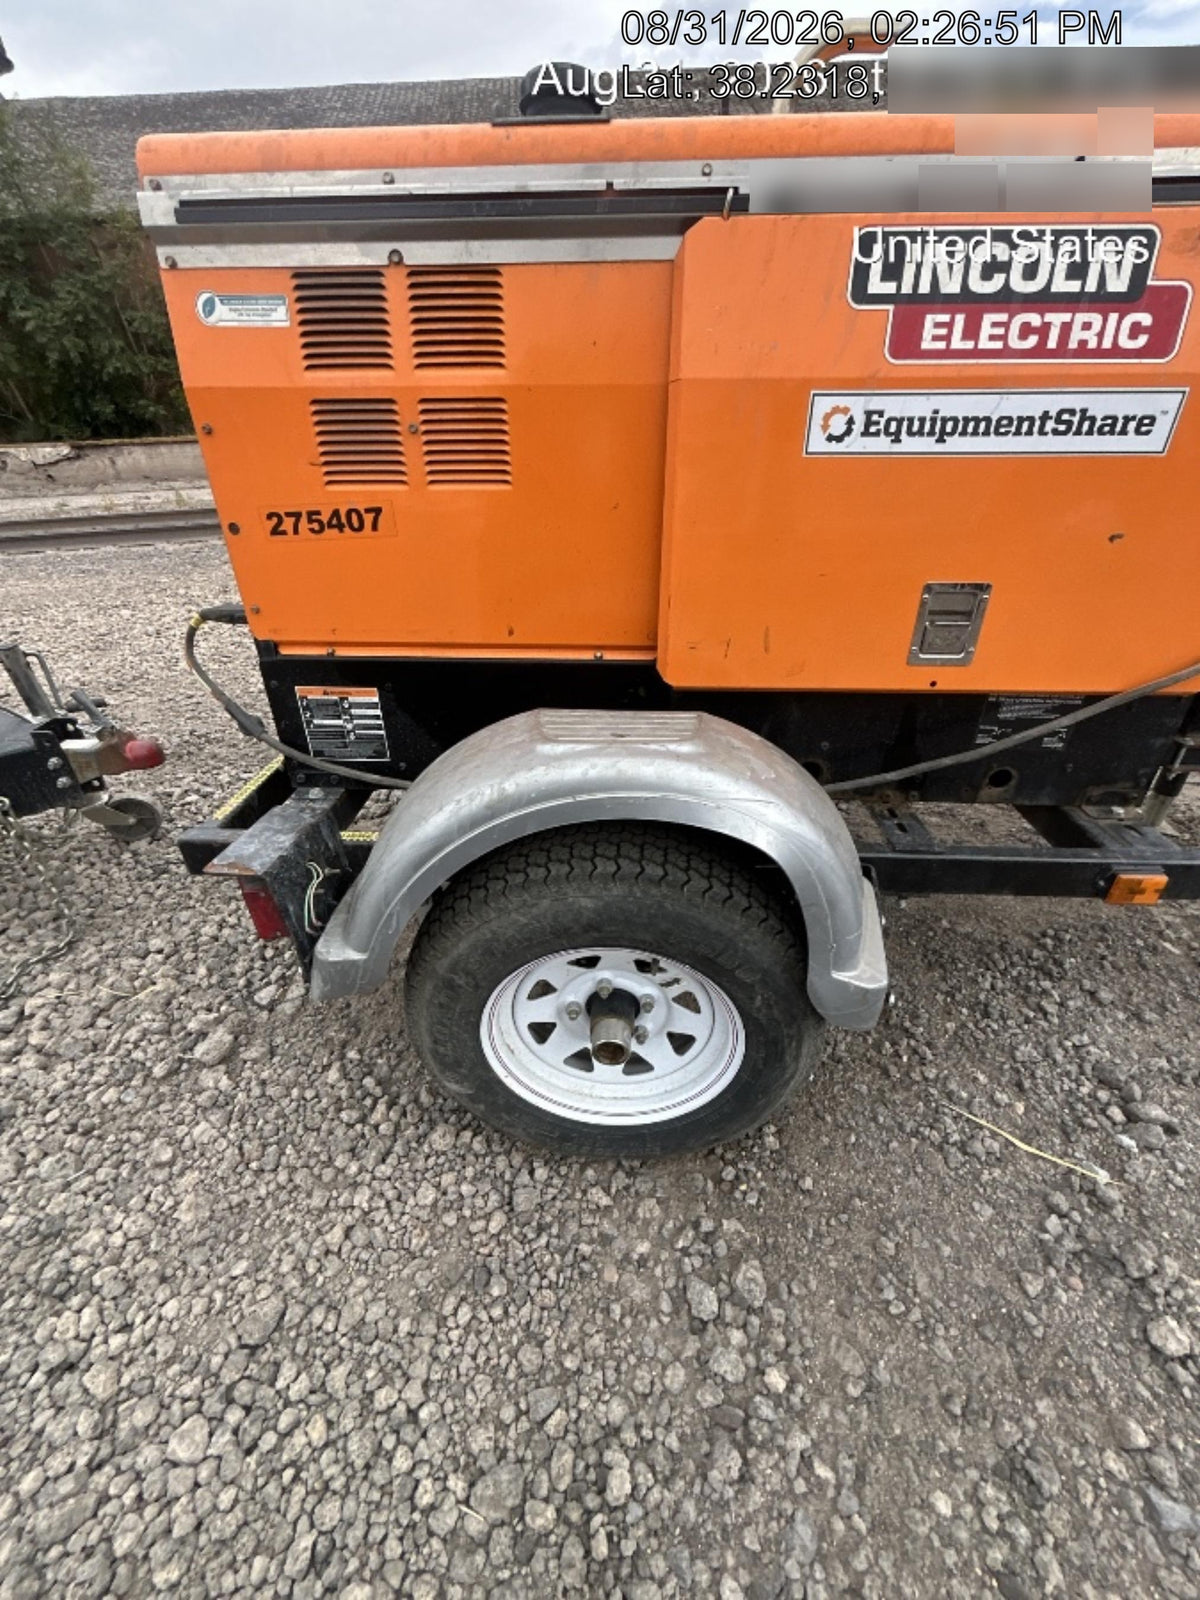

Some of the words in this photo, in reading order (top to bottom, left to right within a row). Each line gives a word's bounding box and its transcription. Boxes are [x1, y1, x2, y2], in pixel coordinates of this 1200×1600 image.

[920, 312, 1153, 350] ELECTRIC
[860, 408, 1157, 444] EquipmentShare
[266, 506, 383, 536] 275407
